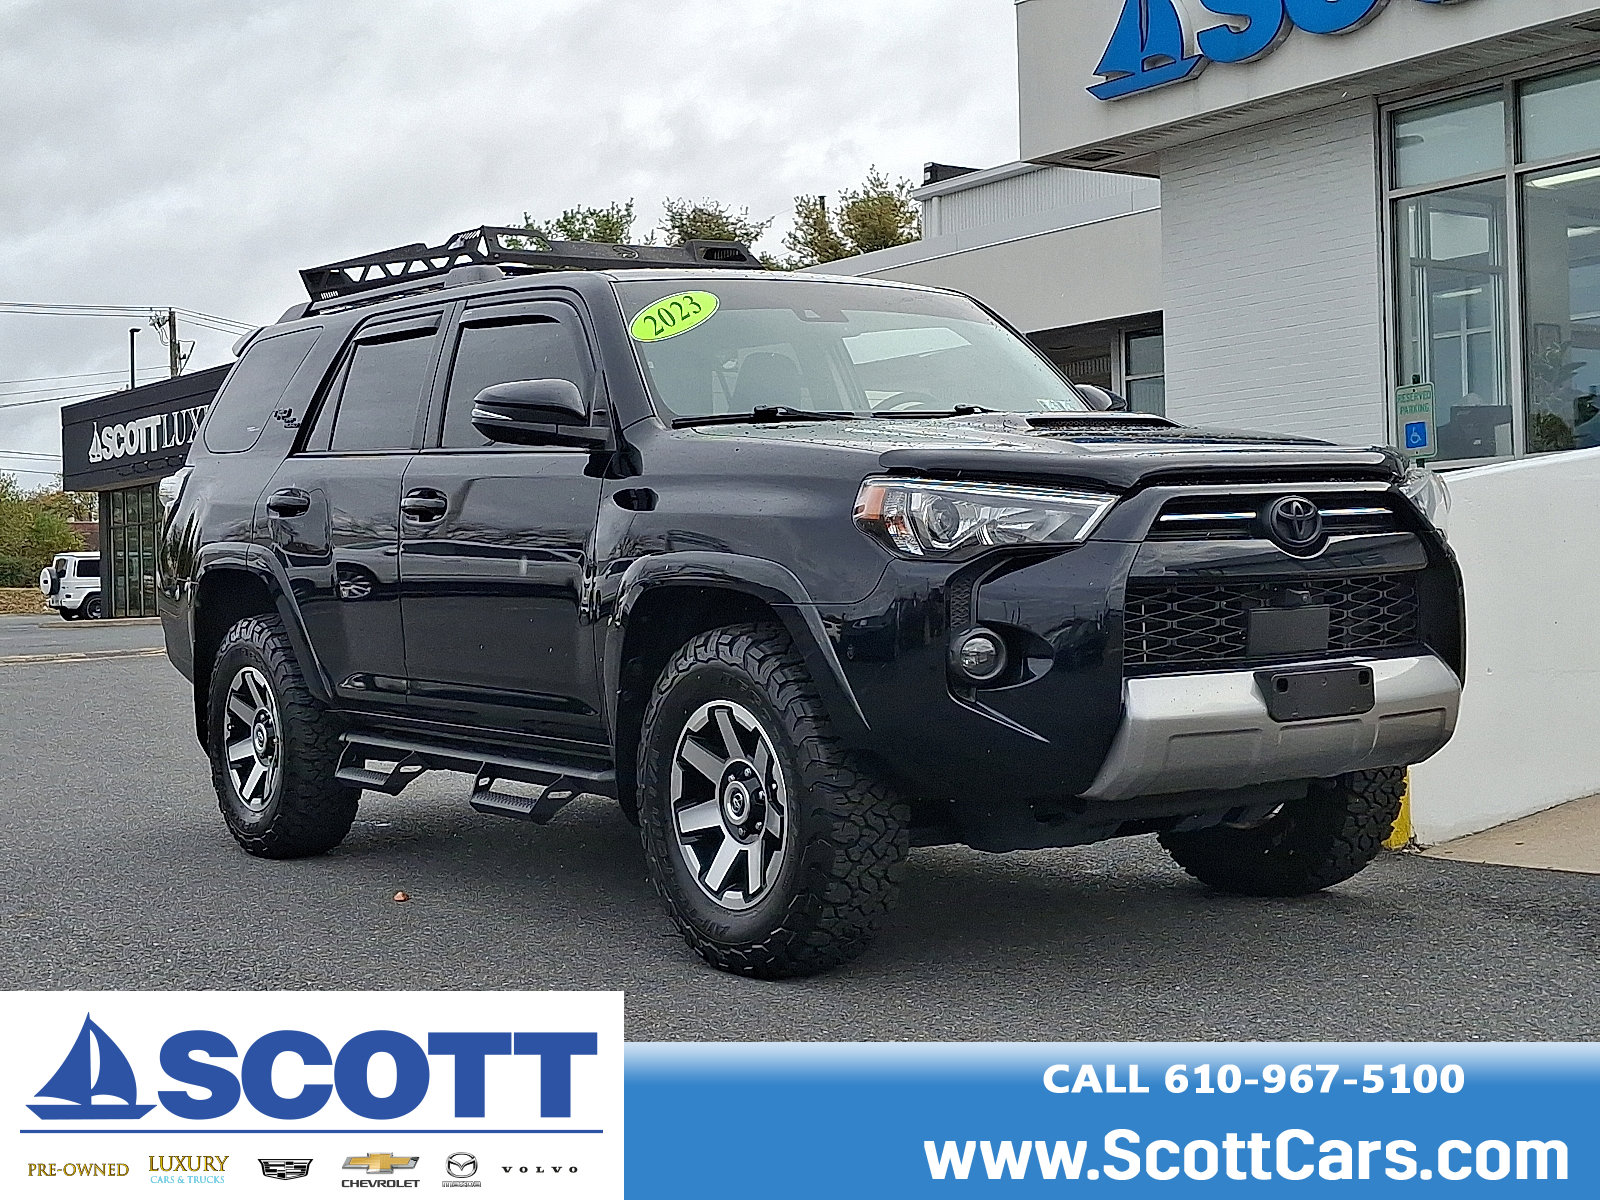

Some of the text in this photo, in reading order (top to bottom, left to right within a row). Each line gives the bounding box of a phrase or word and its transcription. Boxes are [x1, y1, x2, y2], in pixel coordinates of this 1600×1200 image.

[643, 295, 702, 336] 2023
[1397, 391, 1432, 403] RESERVED
[1400, 403, 1430, 415] PARKING
[101, 404, 209, 461] SCOTT LUX
